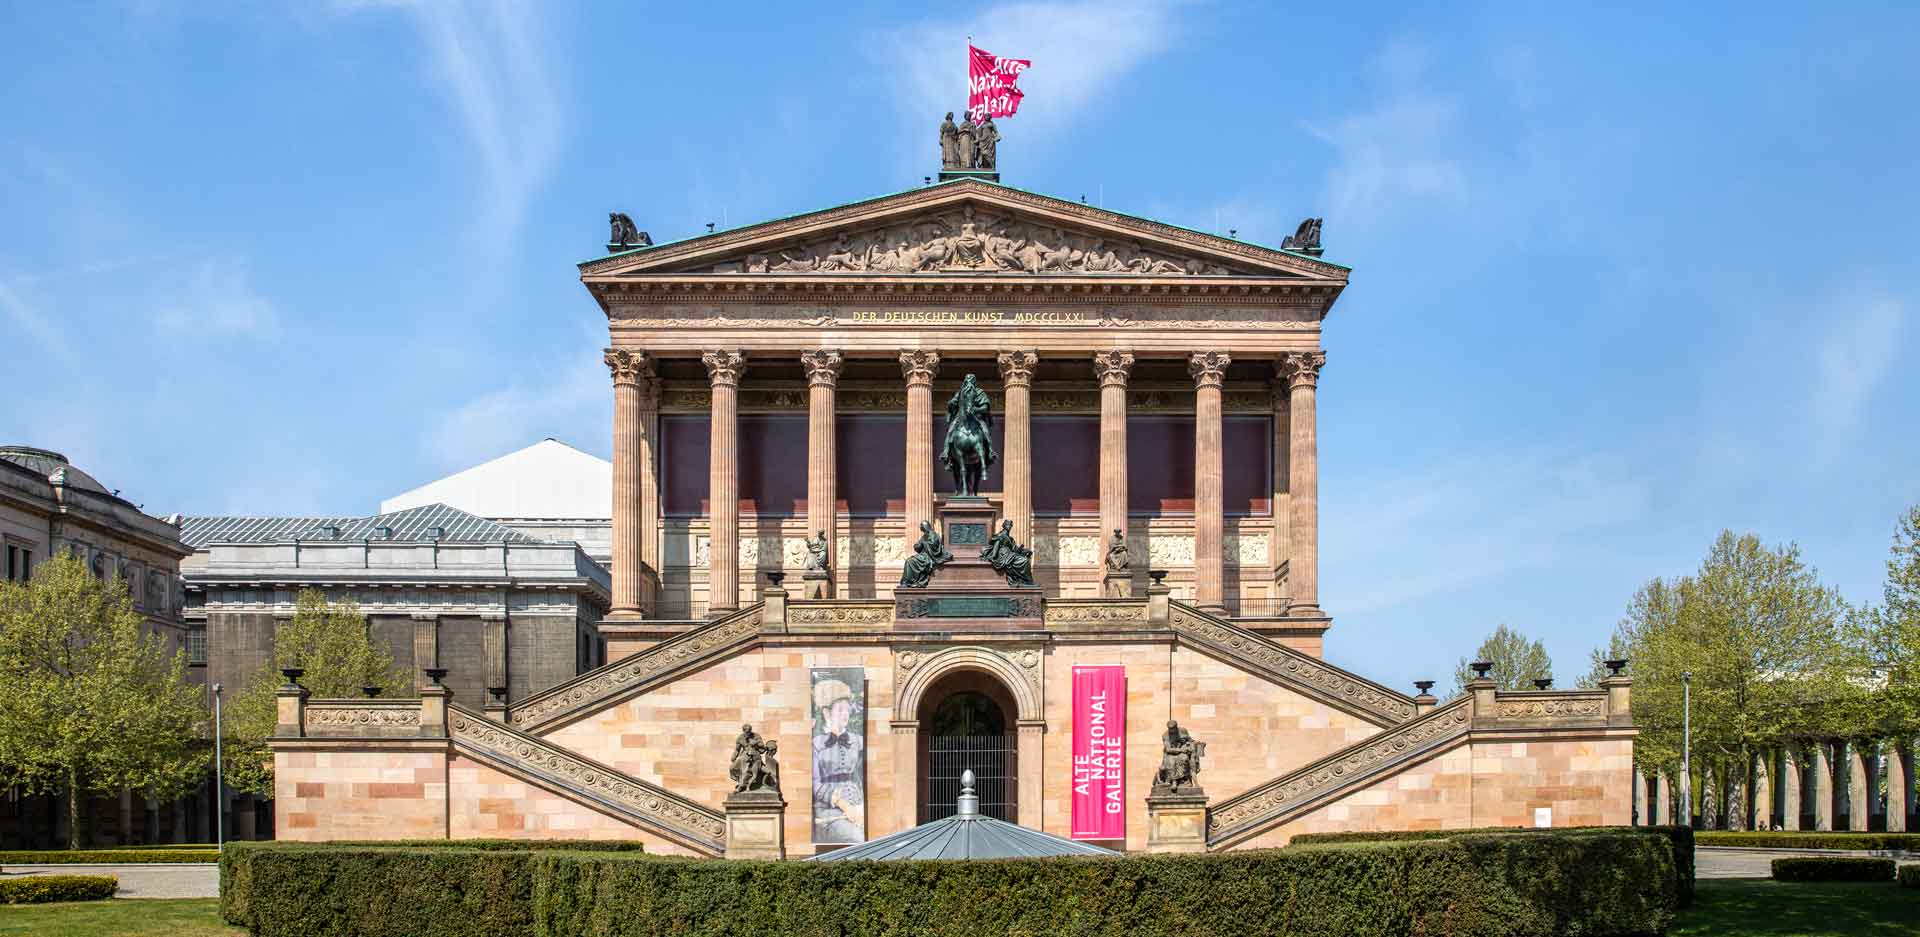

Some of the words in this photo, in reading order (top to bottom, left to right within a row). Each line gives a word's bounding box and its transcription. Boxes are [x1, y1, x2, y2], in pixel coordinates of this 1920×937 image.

[990, 56, 1026, 75] Alte
[853, 311, 877, 321] DER
[884, 311, 957, 321] DEUTSCHEN
[964, 311, 1005, 321] KUNST
[1015, 312, 1085, 321] MDCCCLXXI
[1091, 690, 1106, 780] NATIONAL
[1075, 755, 1089, 795] ALTE
[1106, 736, 1121, 814] GALERIE
